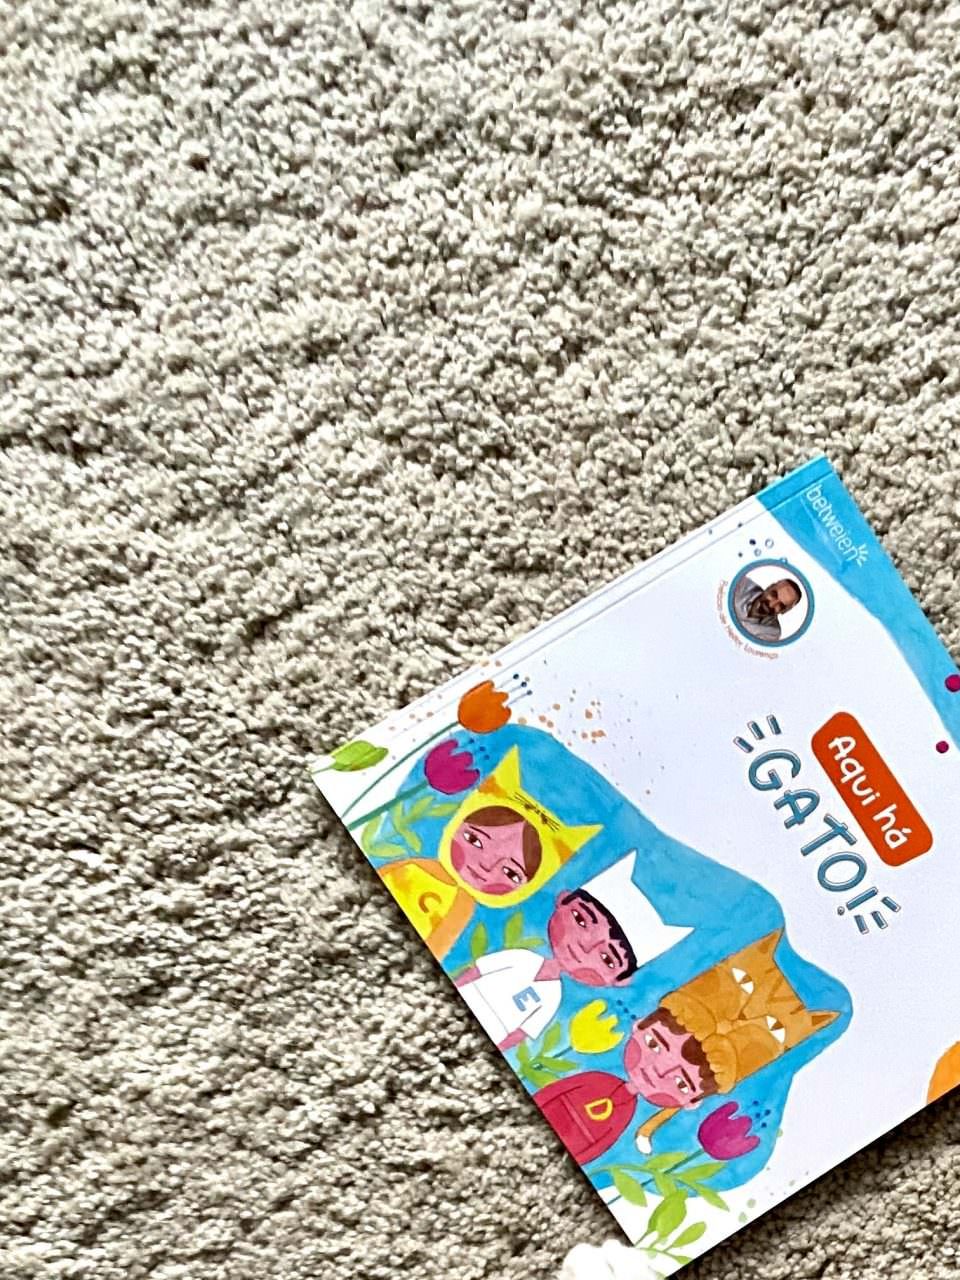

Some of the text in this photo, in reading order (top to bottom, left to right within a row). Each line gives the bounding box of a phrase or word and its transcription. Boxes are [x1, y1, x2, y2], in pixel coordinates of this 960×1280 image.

[806, 484, 858, 562] betweien
[827, 735, 912, 850] Aqui há
[748, 748, 878, 916] GATO!
[418, 891, 442, 914] C
[512, 986, 541, 1012] E
[584, 1097, 614, 1121] D
